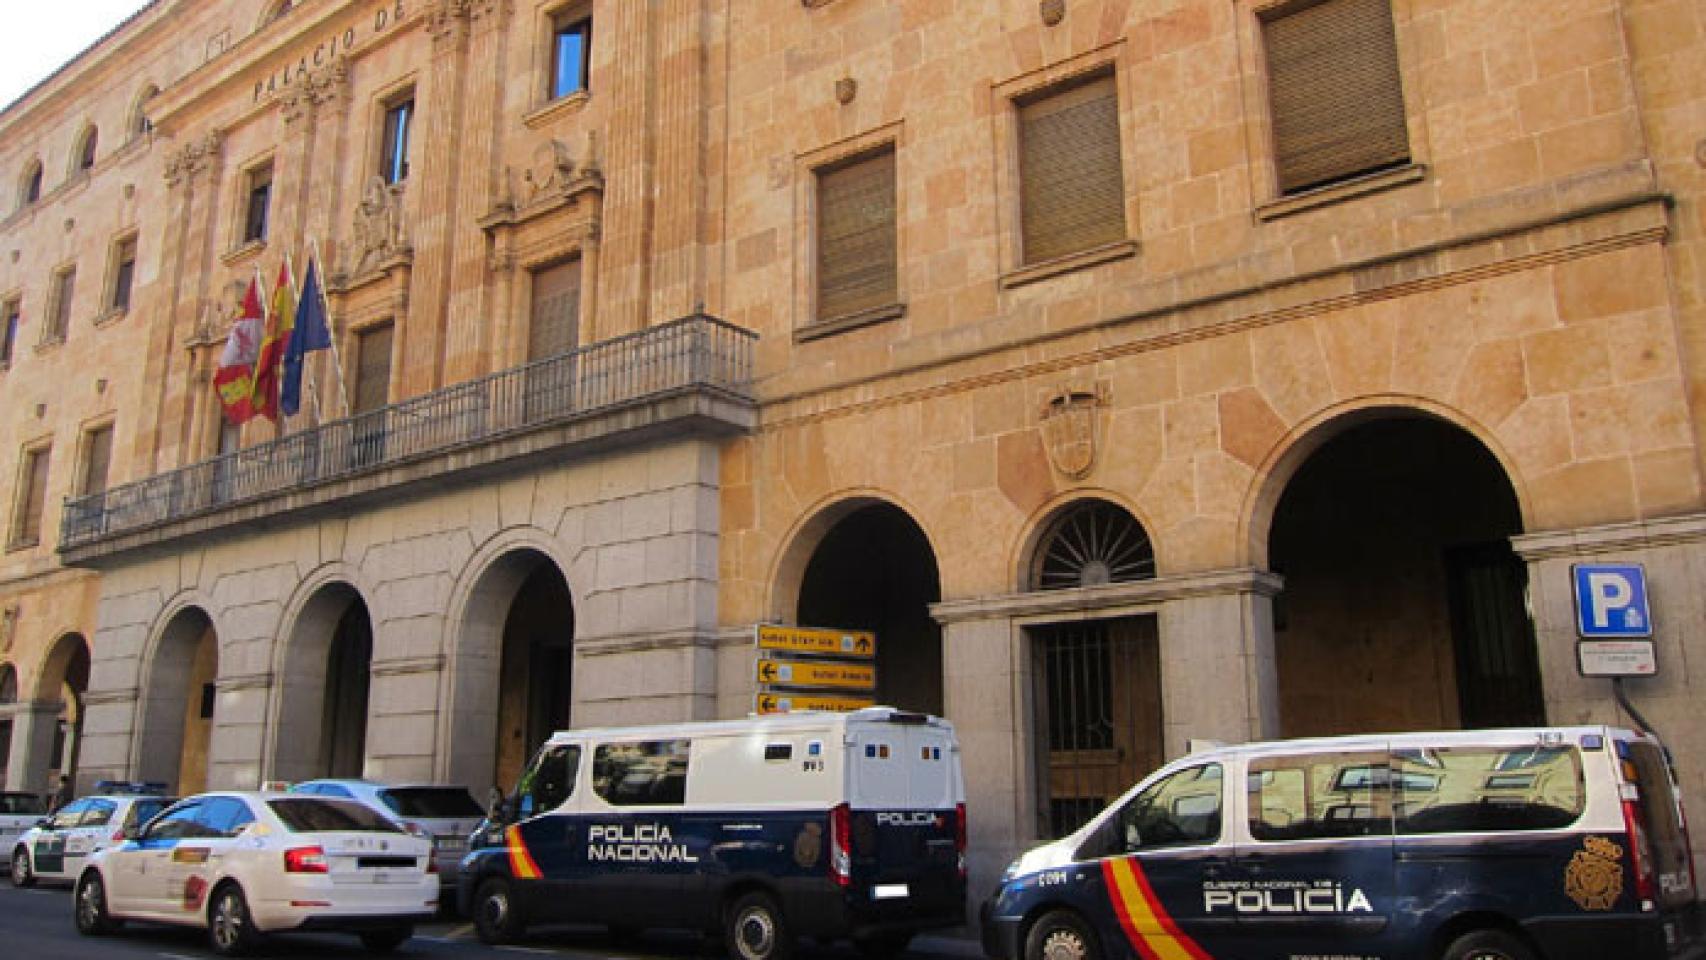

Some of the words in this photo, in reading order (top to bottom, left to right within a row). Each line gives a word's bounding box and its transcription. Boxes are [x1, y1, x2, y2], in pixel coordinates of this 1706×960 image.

[254, 27, 354, 103] PALACIO
[374, 0, 405, 32] DE
[1590, 572, 1632, 628] P
[587, 822, 672, 843] POLICÍA
[587, 844, 699, 862] NACIONAL
[1204, 881, 1373, 912] POLICÍA
